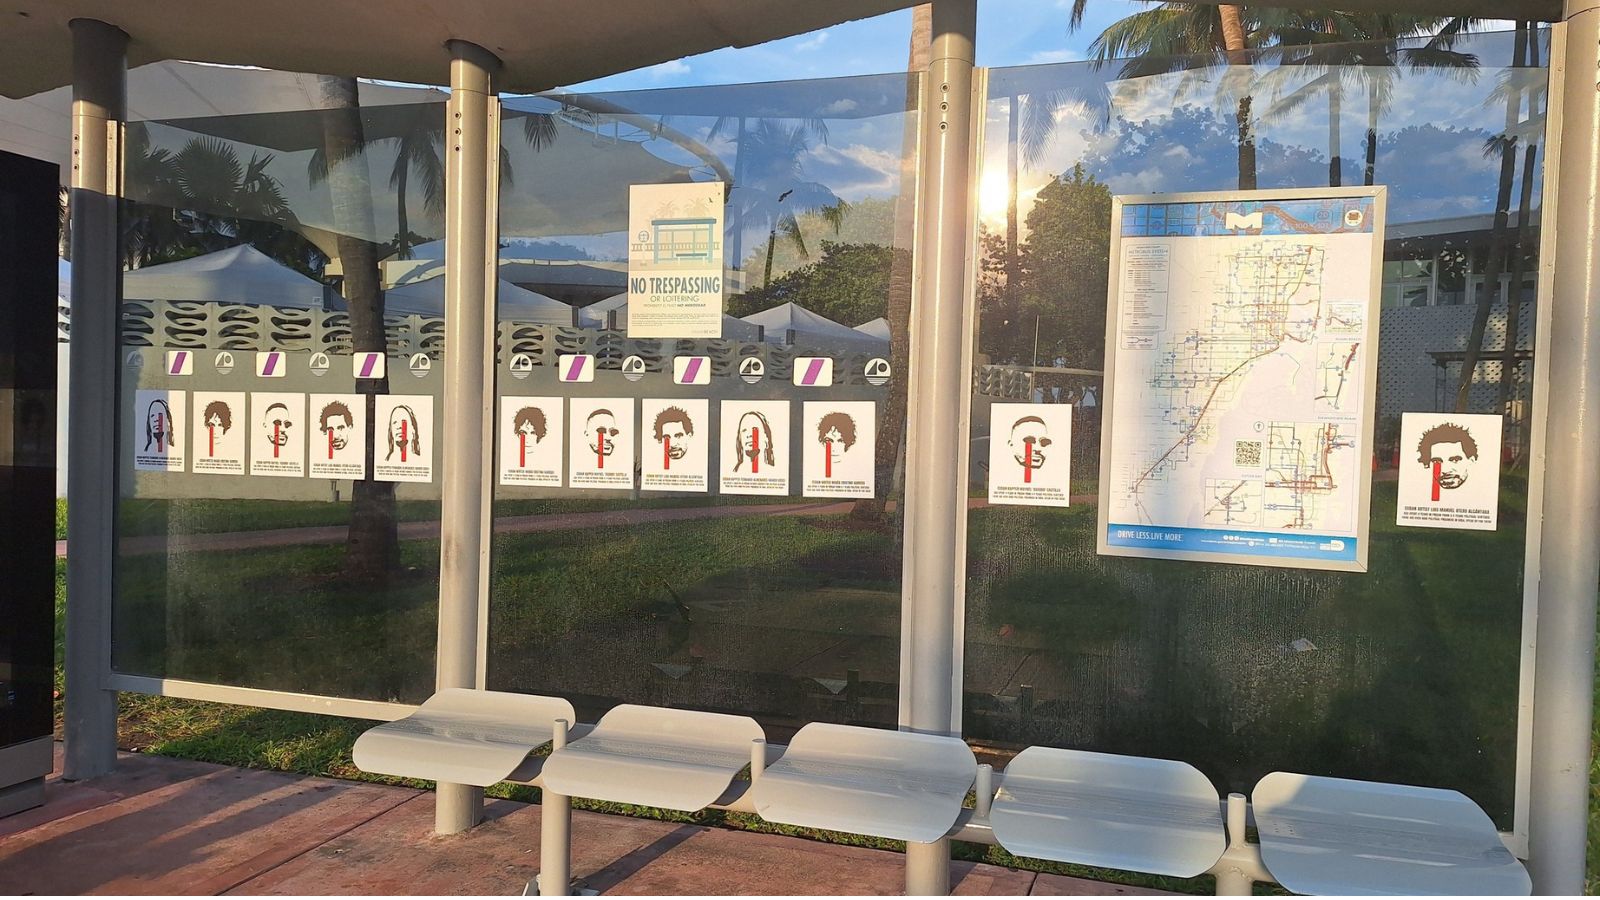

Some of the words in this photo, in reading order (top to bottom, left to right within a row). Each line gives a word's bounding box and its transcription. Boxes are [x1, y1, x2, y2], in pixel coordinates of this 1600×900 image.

[630, 277, 647, 294] NO
[649, 276, 721, 294] TRESPASSING
[650, 295, 661, 303] OR
[663, 295, 700, 303] LOITERING
[1117, 530, 1135, 539] DRIVE
[1164, 532, 1183, 542] MORE
